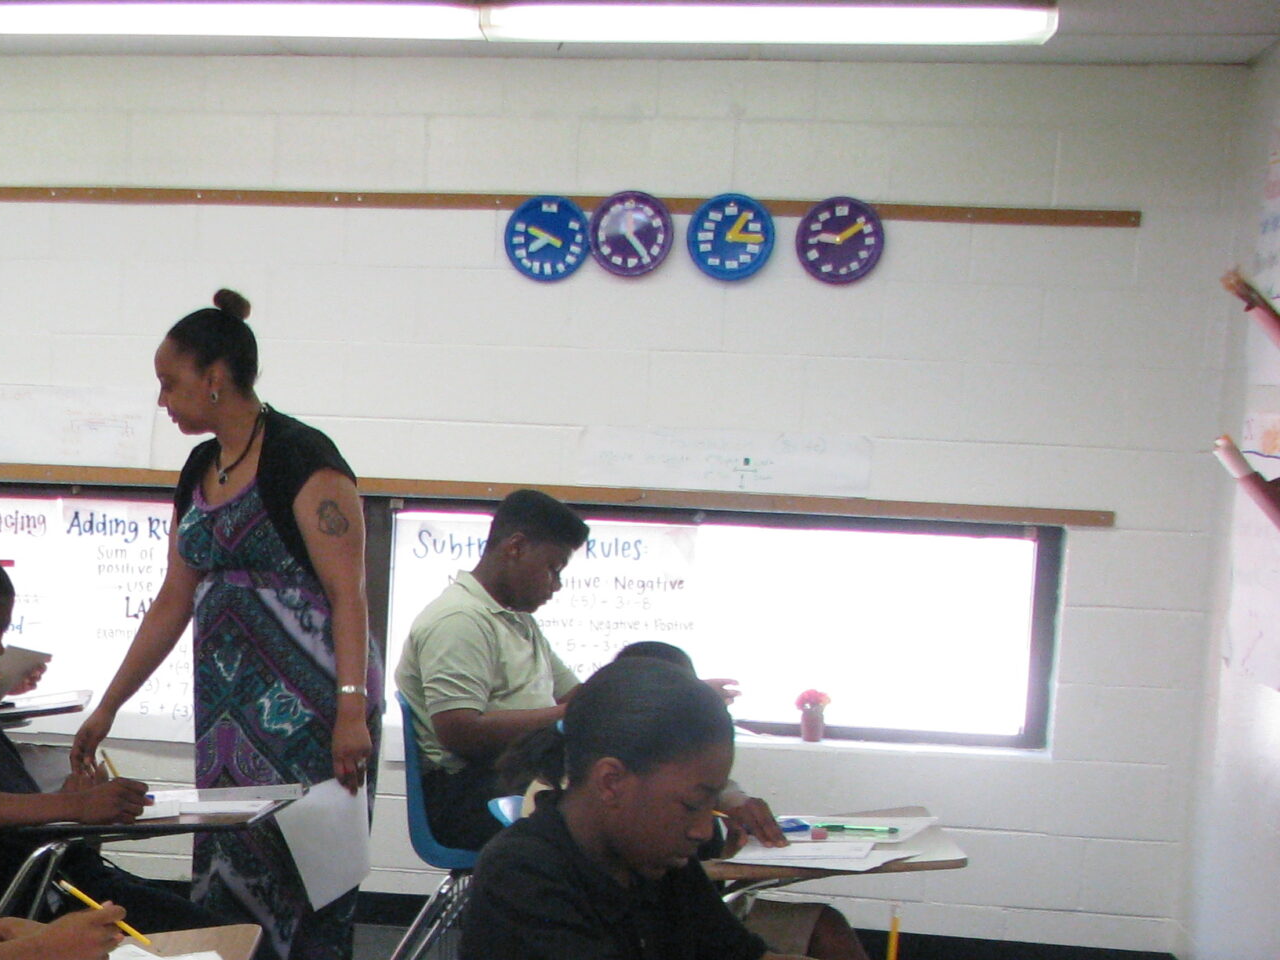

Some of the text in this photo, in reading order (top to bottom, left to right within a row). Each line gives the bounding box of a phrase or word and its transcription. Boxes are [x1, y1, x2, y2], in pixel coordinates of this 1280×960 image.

[66, 510, 139, 543] Adding
[97, 544, 154, 560] Sum of
[413, 529, 487, 560] Subtr
[613, 575, 685, 596] Negative
[125, 596, 154, 619] LA
[589, 618, 640, 636] Negative
[140, 701, 150, 716] 5
